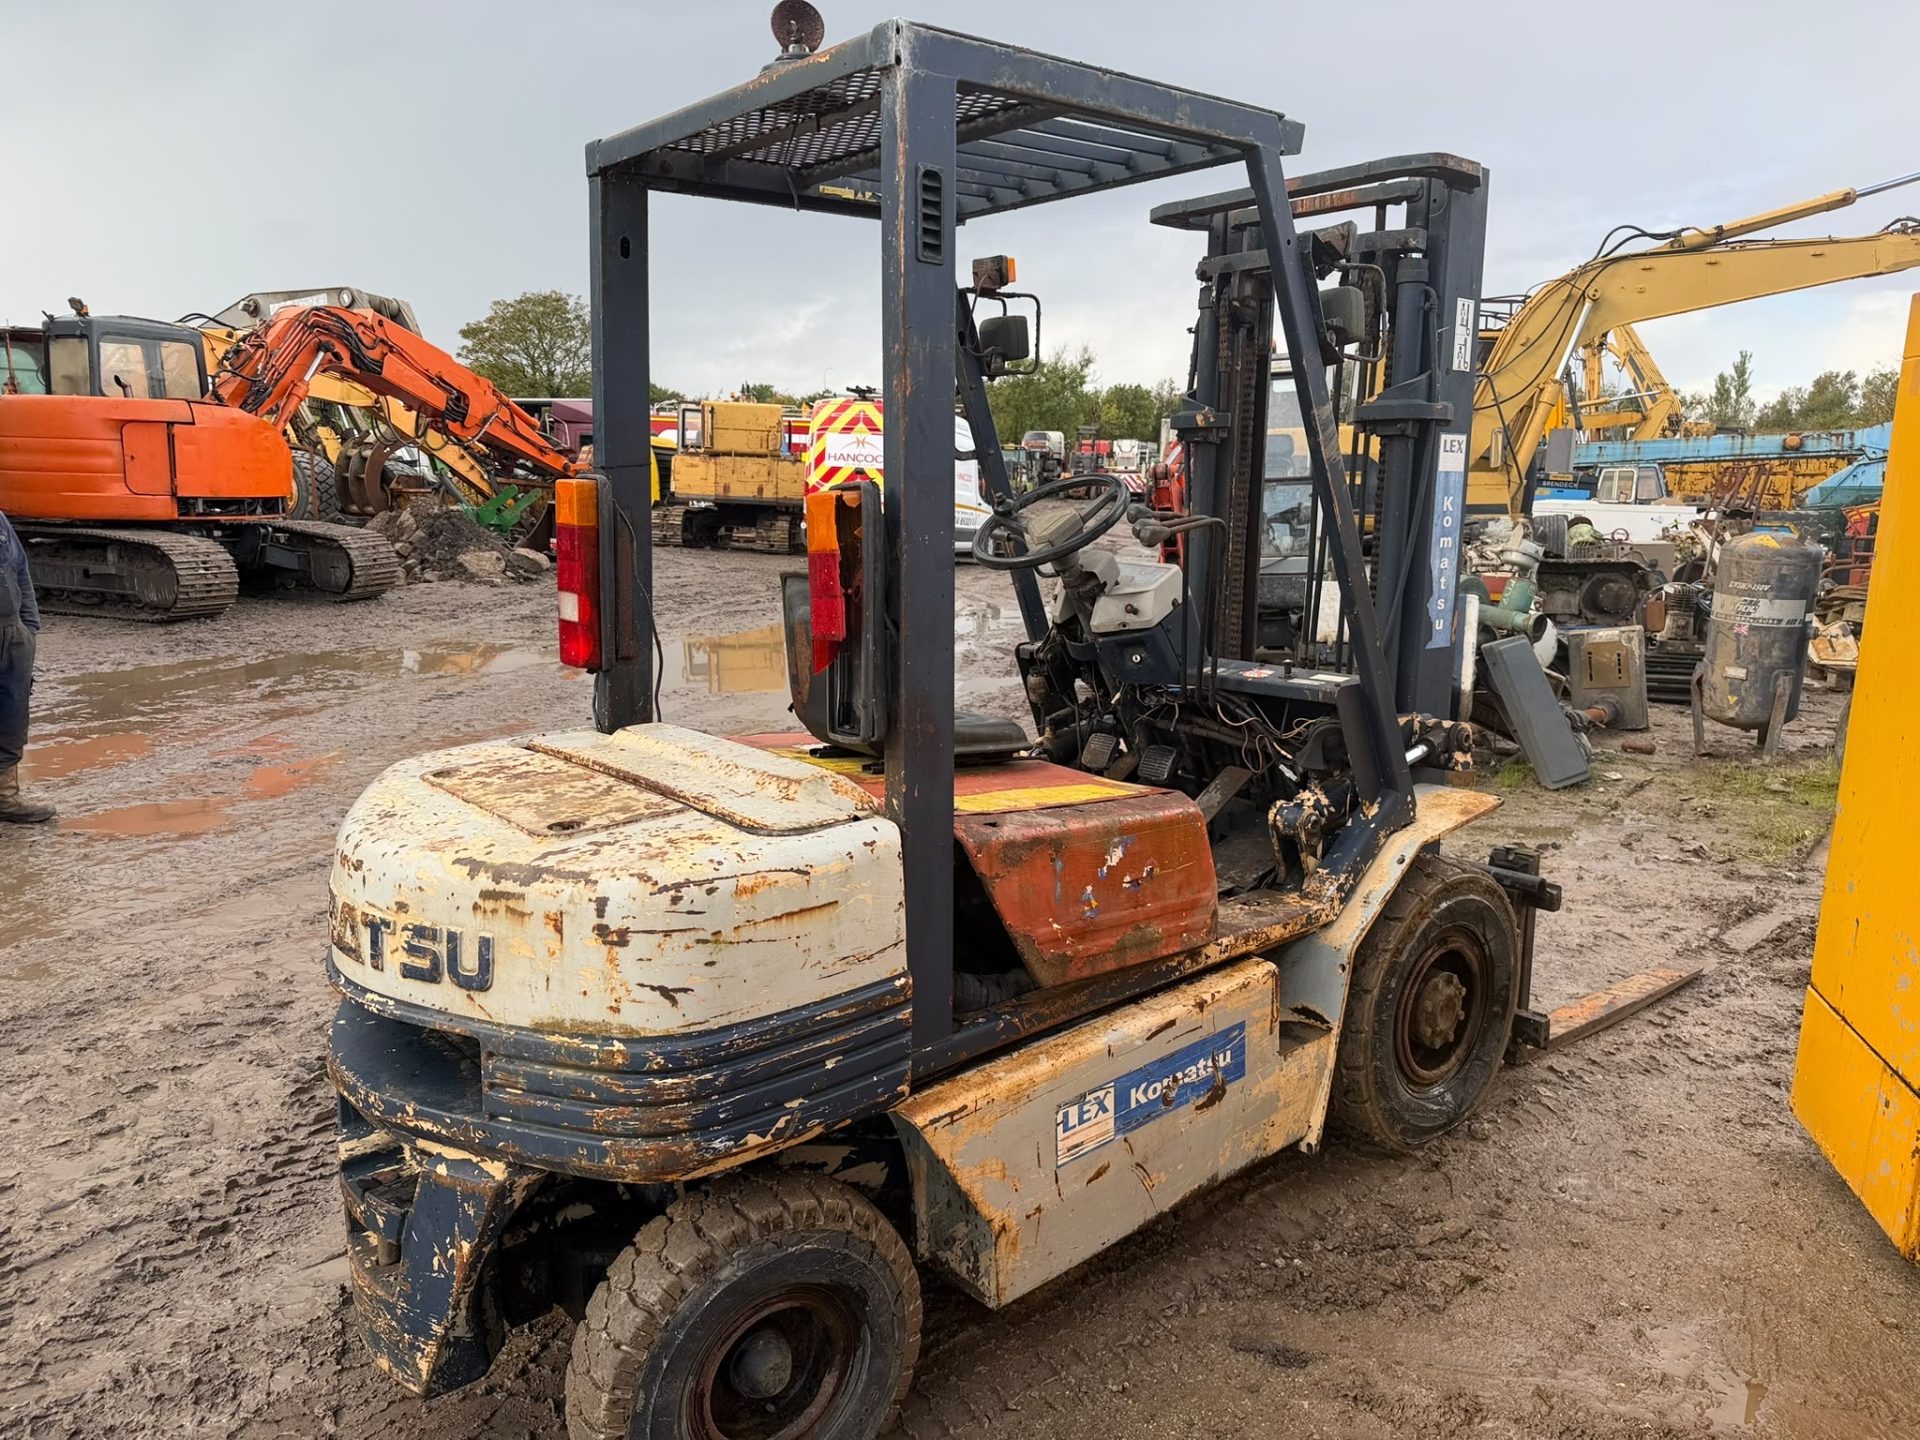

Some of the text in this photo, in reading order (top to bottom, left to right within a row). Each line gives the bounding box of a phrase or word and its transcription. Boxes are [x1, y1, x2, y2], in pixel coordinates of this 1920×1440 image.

[828, 452, 883, 464] HANCOC
[1443, 439, 1464, 453] LEX
[1435, 496, 1455, 630] Komatsu
[330, 896, 494, 992] ATSU
[1061, 1089, 1112, 1134] LEX
